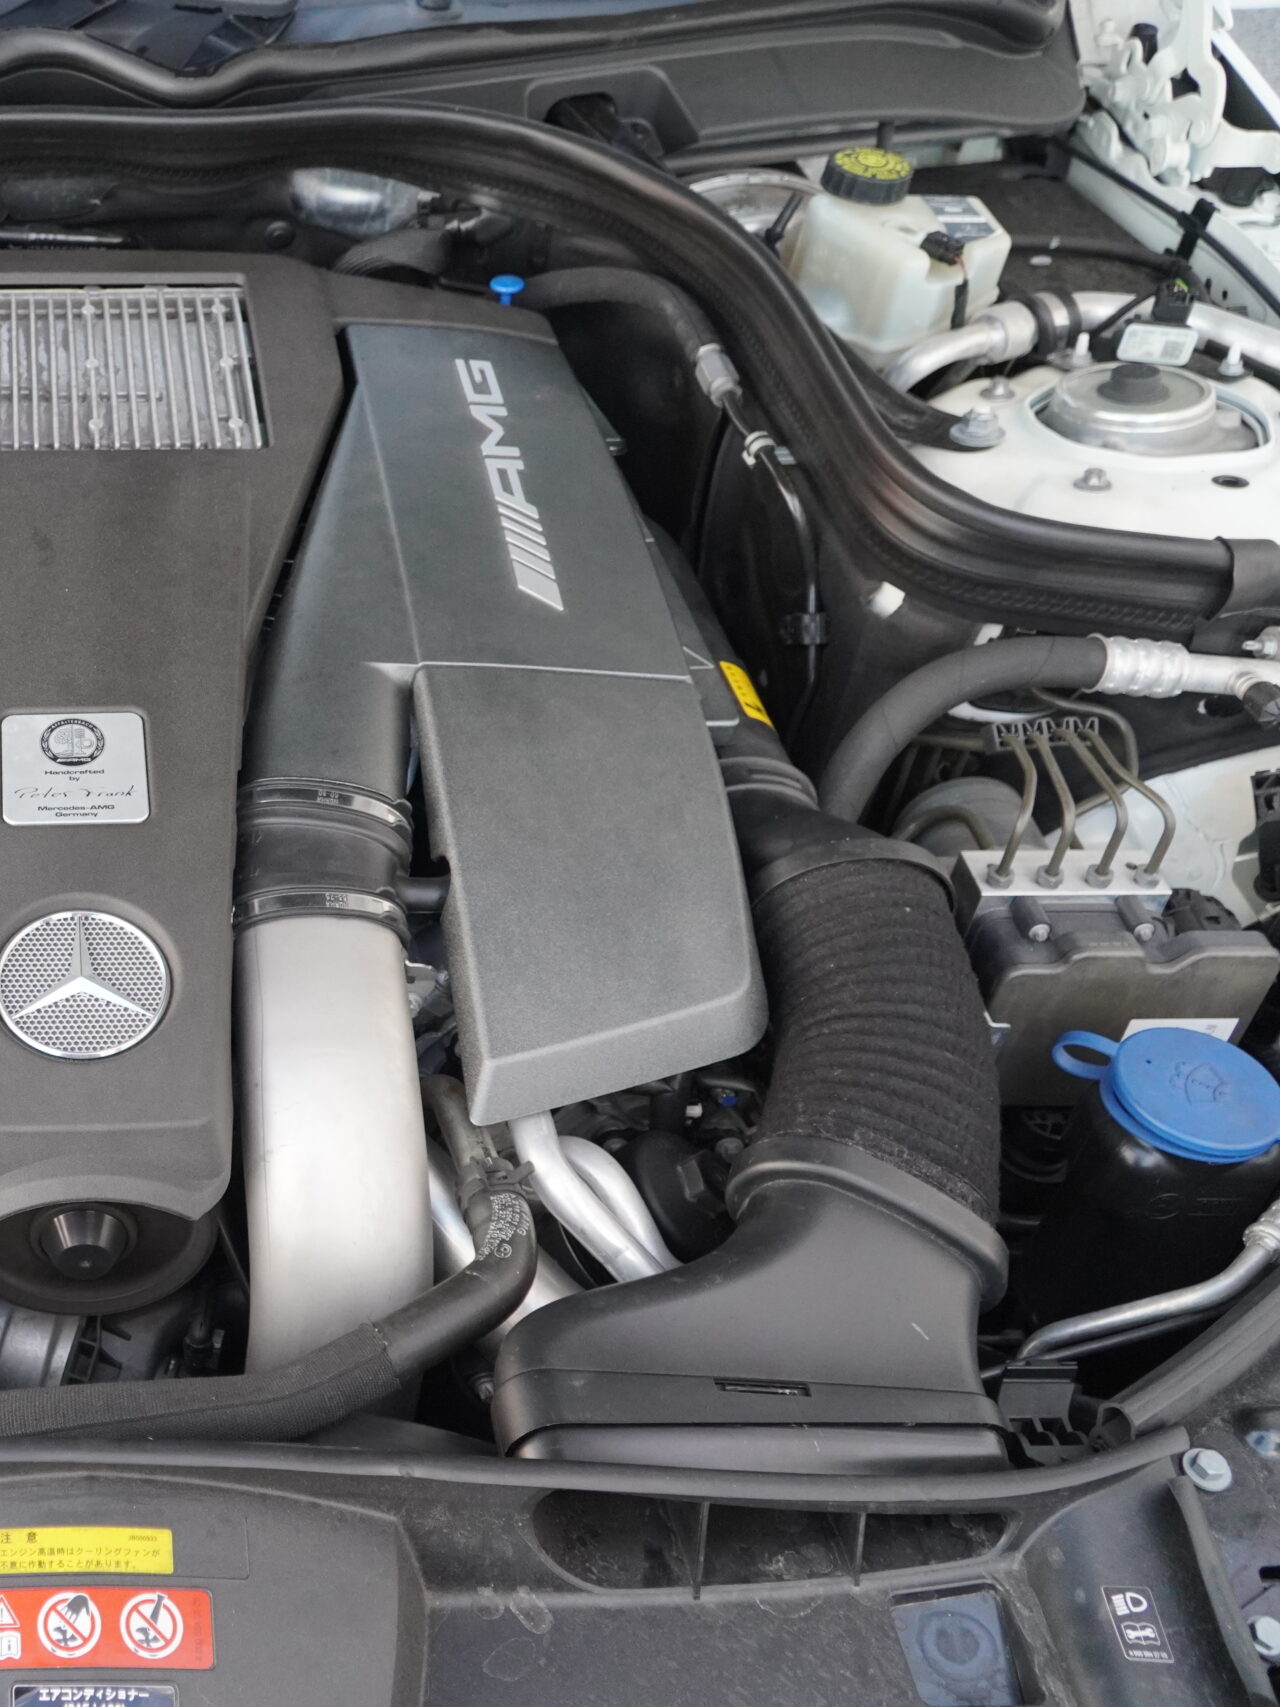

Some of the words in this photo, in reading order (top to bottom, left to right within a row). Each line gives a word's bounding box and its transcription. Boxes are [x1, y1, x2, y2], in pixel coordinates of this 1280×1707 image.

[39, 1688, 150, 1701] エアコンディショナー
